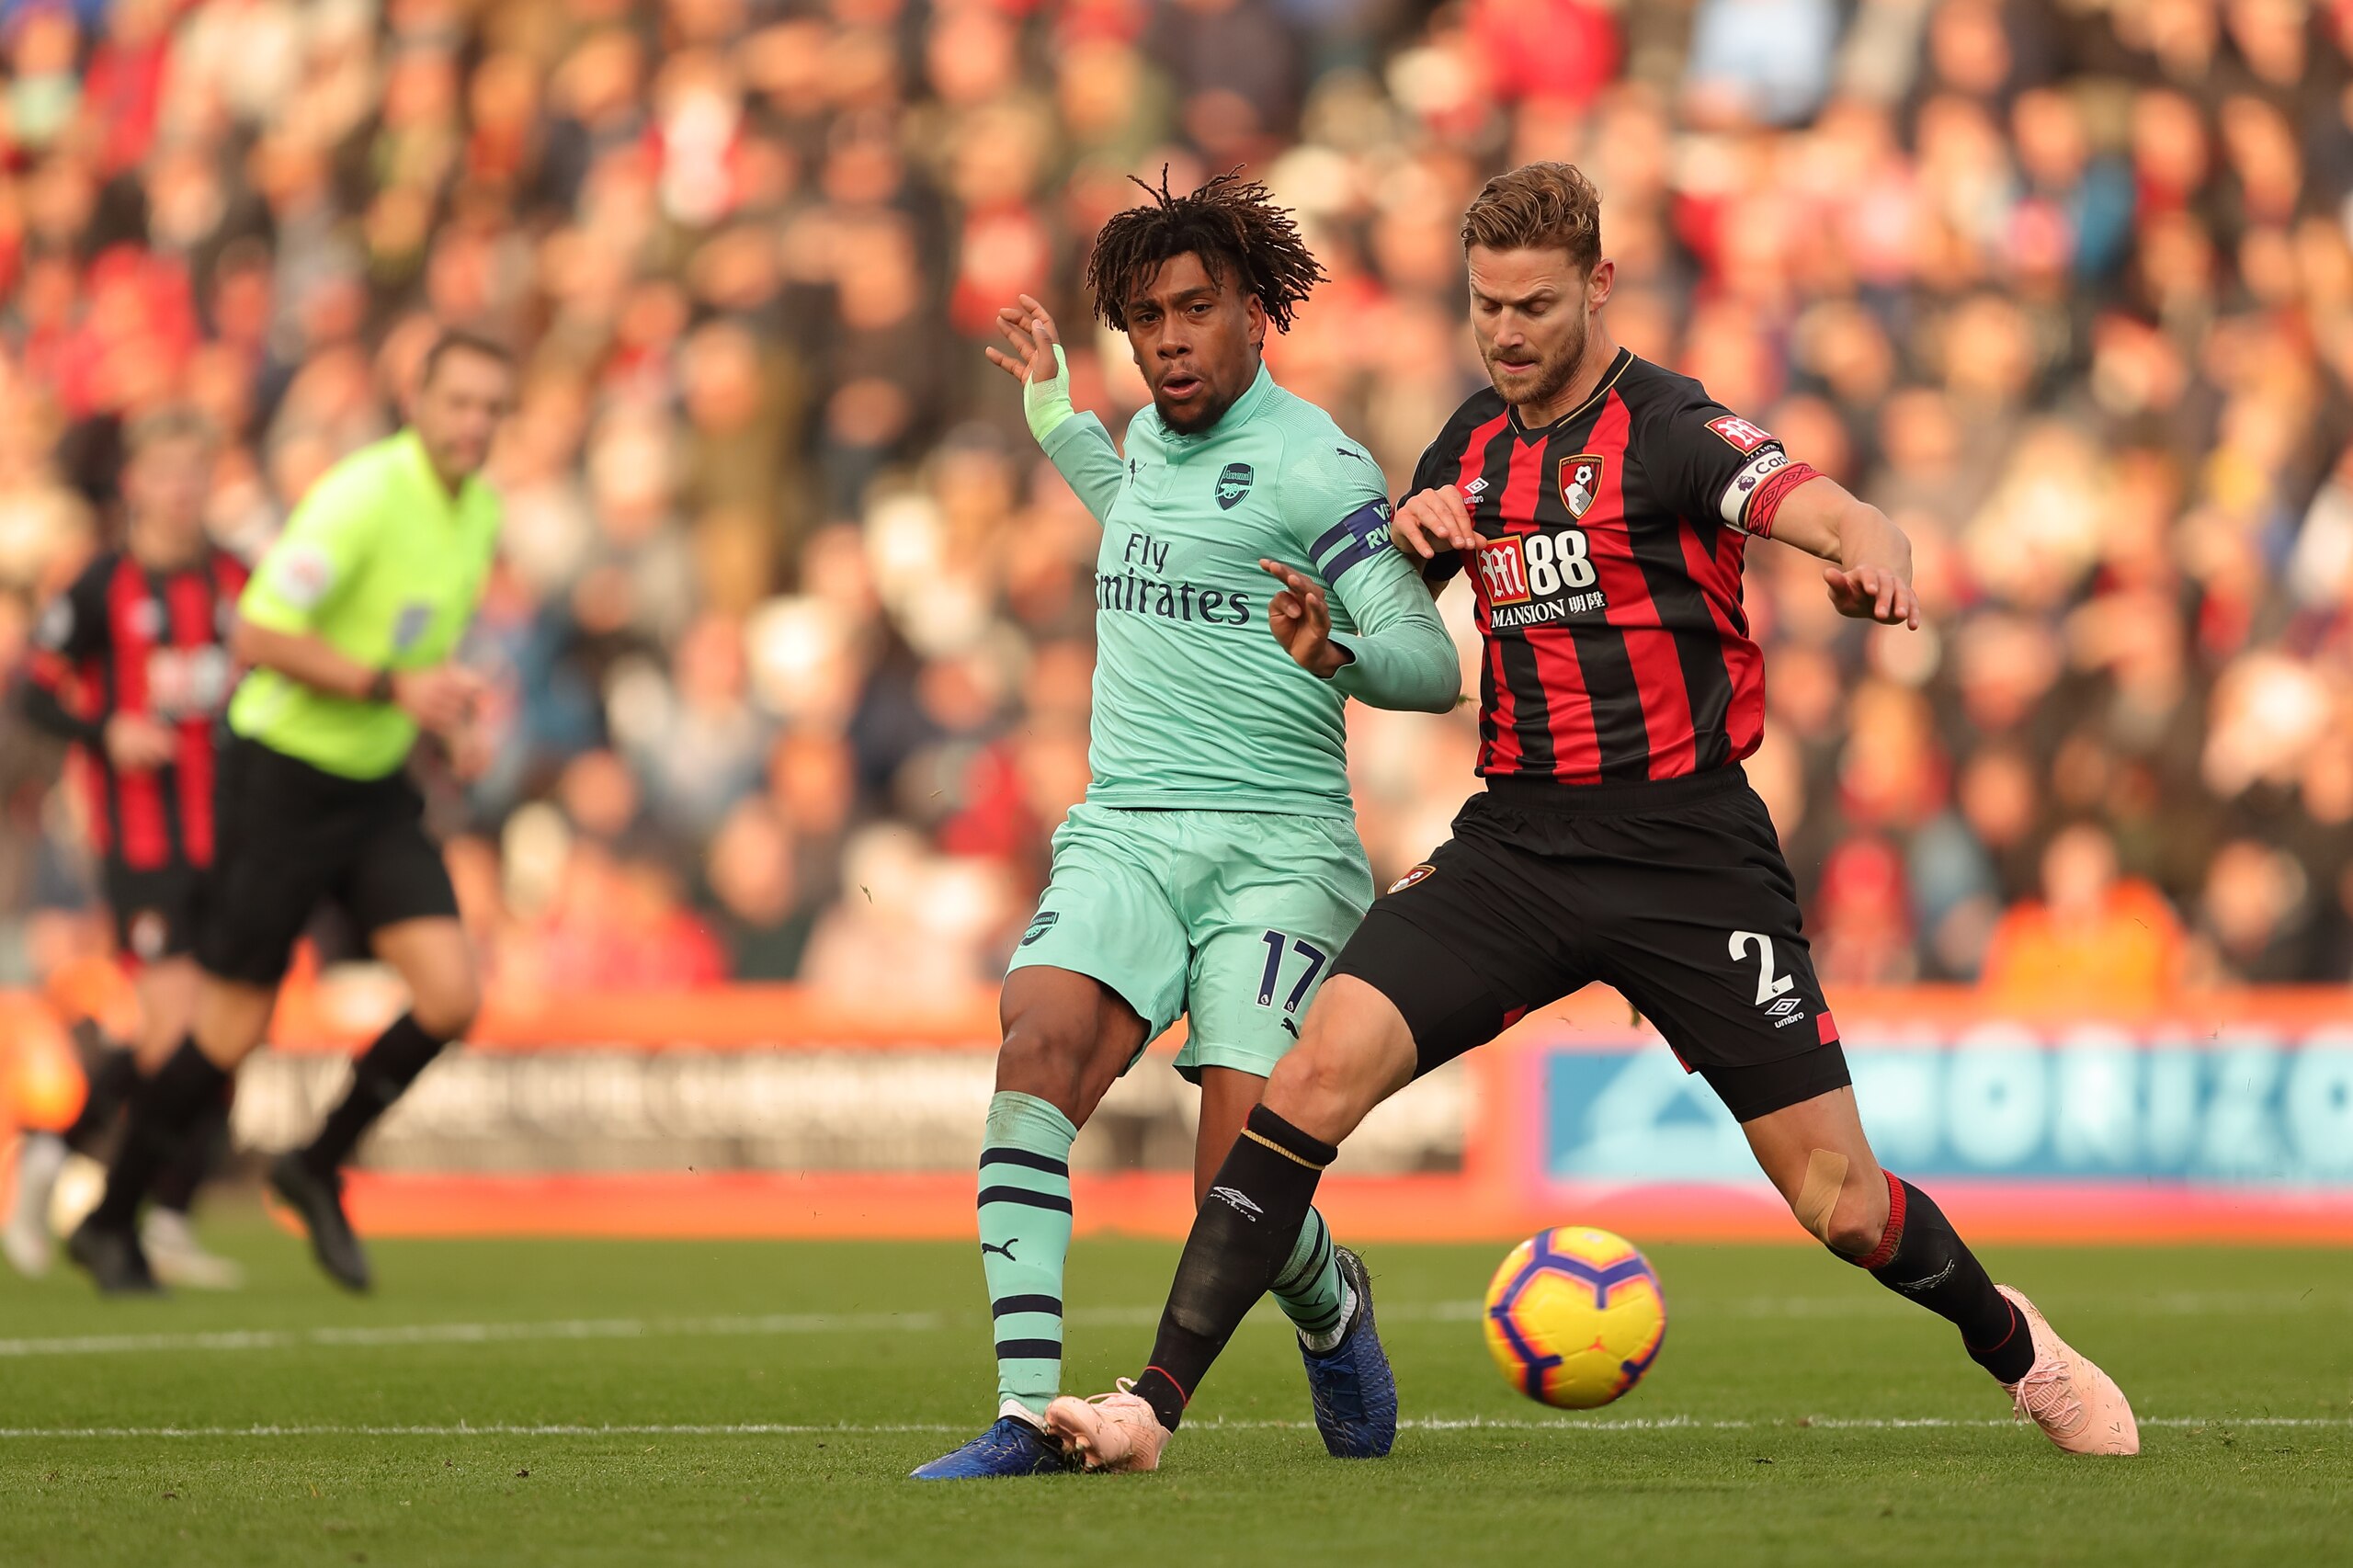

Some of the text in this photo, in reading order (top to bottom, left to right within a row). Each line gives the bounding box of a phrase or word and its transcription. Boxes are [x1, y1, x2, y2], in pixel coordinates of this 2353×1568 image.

[1463, 494, 1484, 505] umbro
[1124, 533, 1169, 574] Fly
[1099, 566, 1250, 626] mirates
[1491, 598, 1565, 629] MANSION
[1256, 928, 1327, 1016] 17
[1728, 930, 1794, 1006] 2
[1774, 1011, 1804, 1028] umbro
